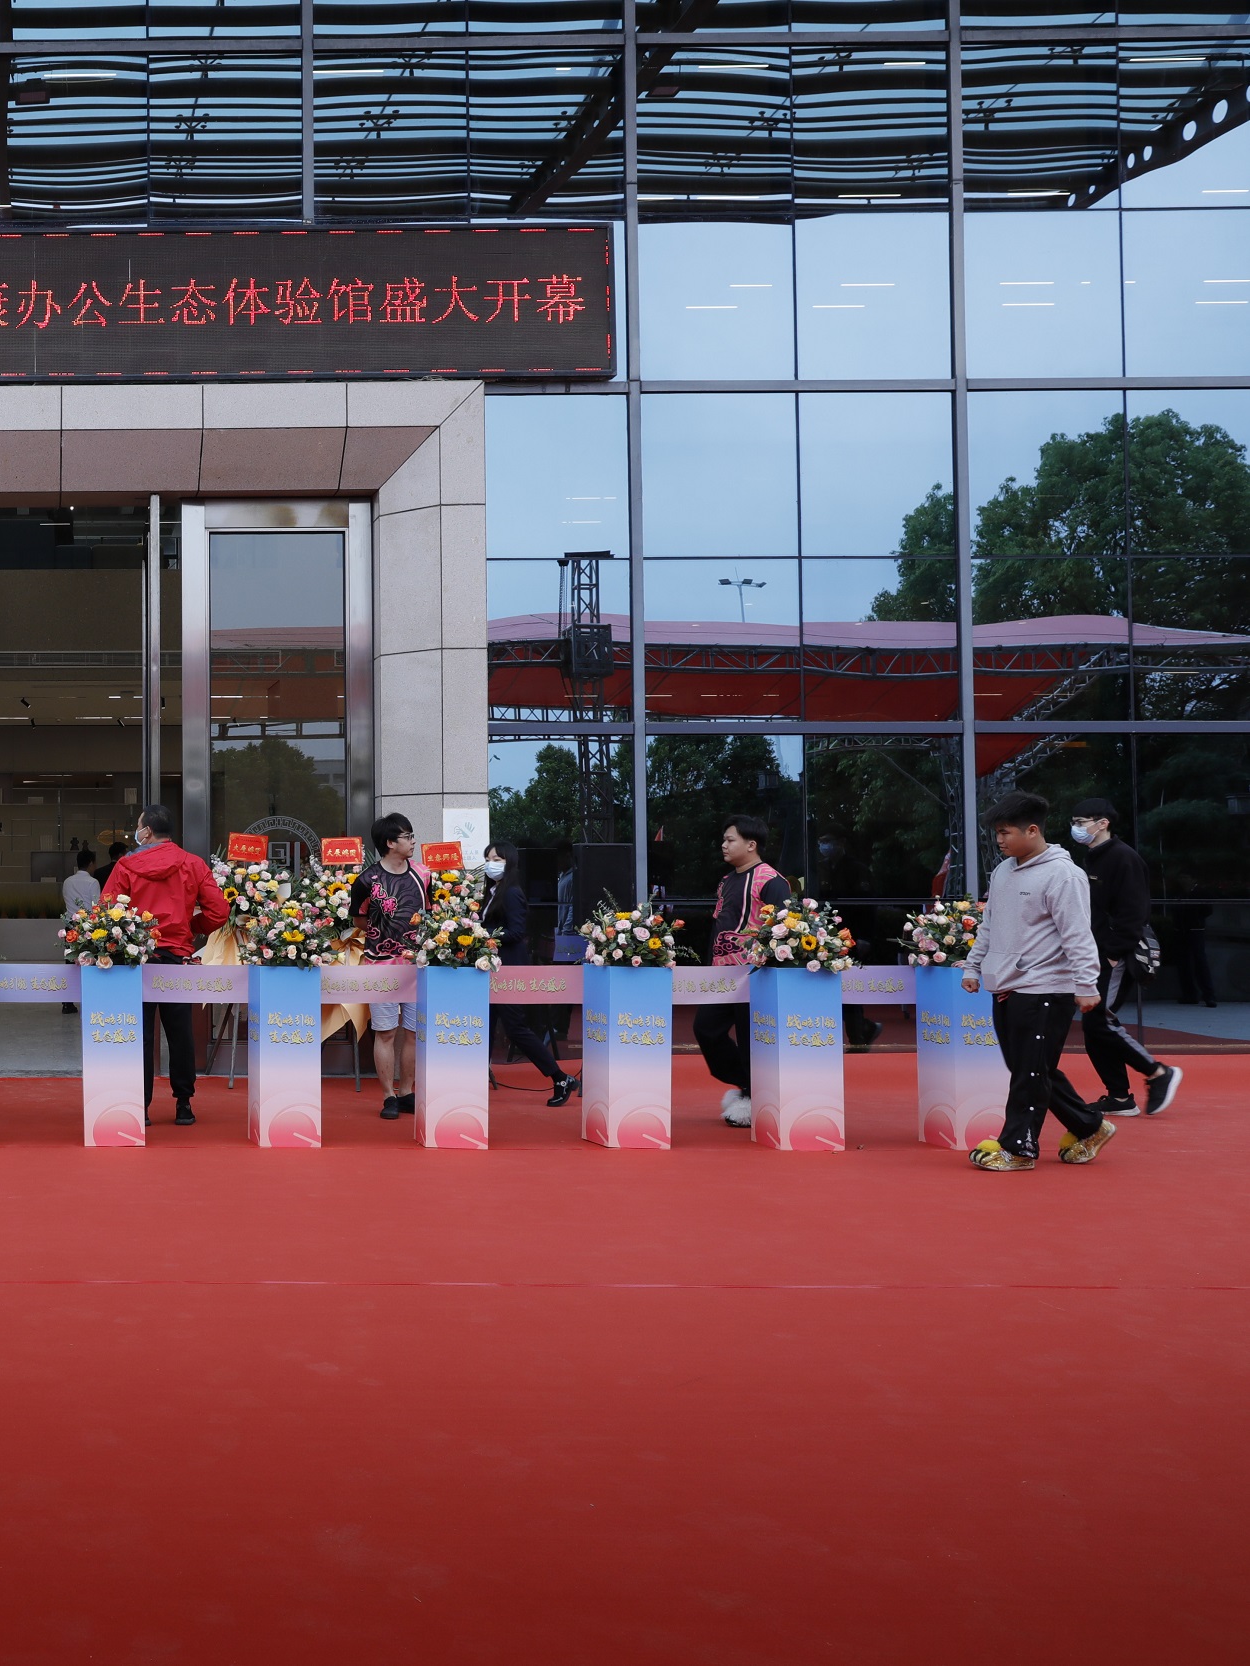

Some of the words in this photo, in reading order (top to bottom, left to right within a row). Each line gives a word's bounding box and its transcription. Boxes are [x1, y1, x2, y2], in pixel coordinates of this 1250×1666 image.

[961, 1013, 993, 1029] 战略引
[963, 1031, 1000, 1046] 生态盛
